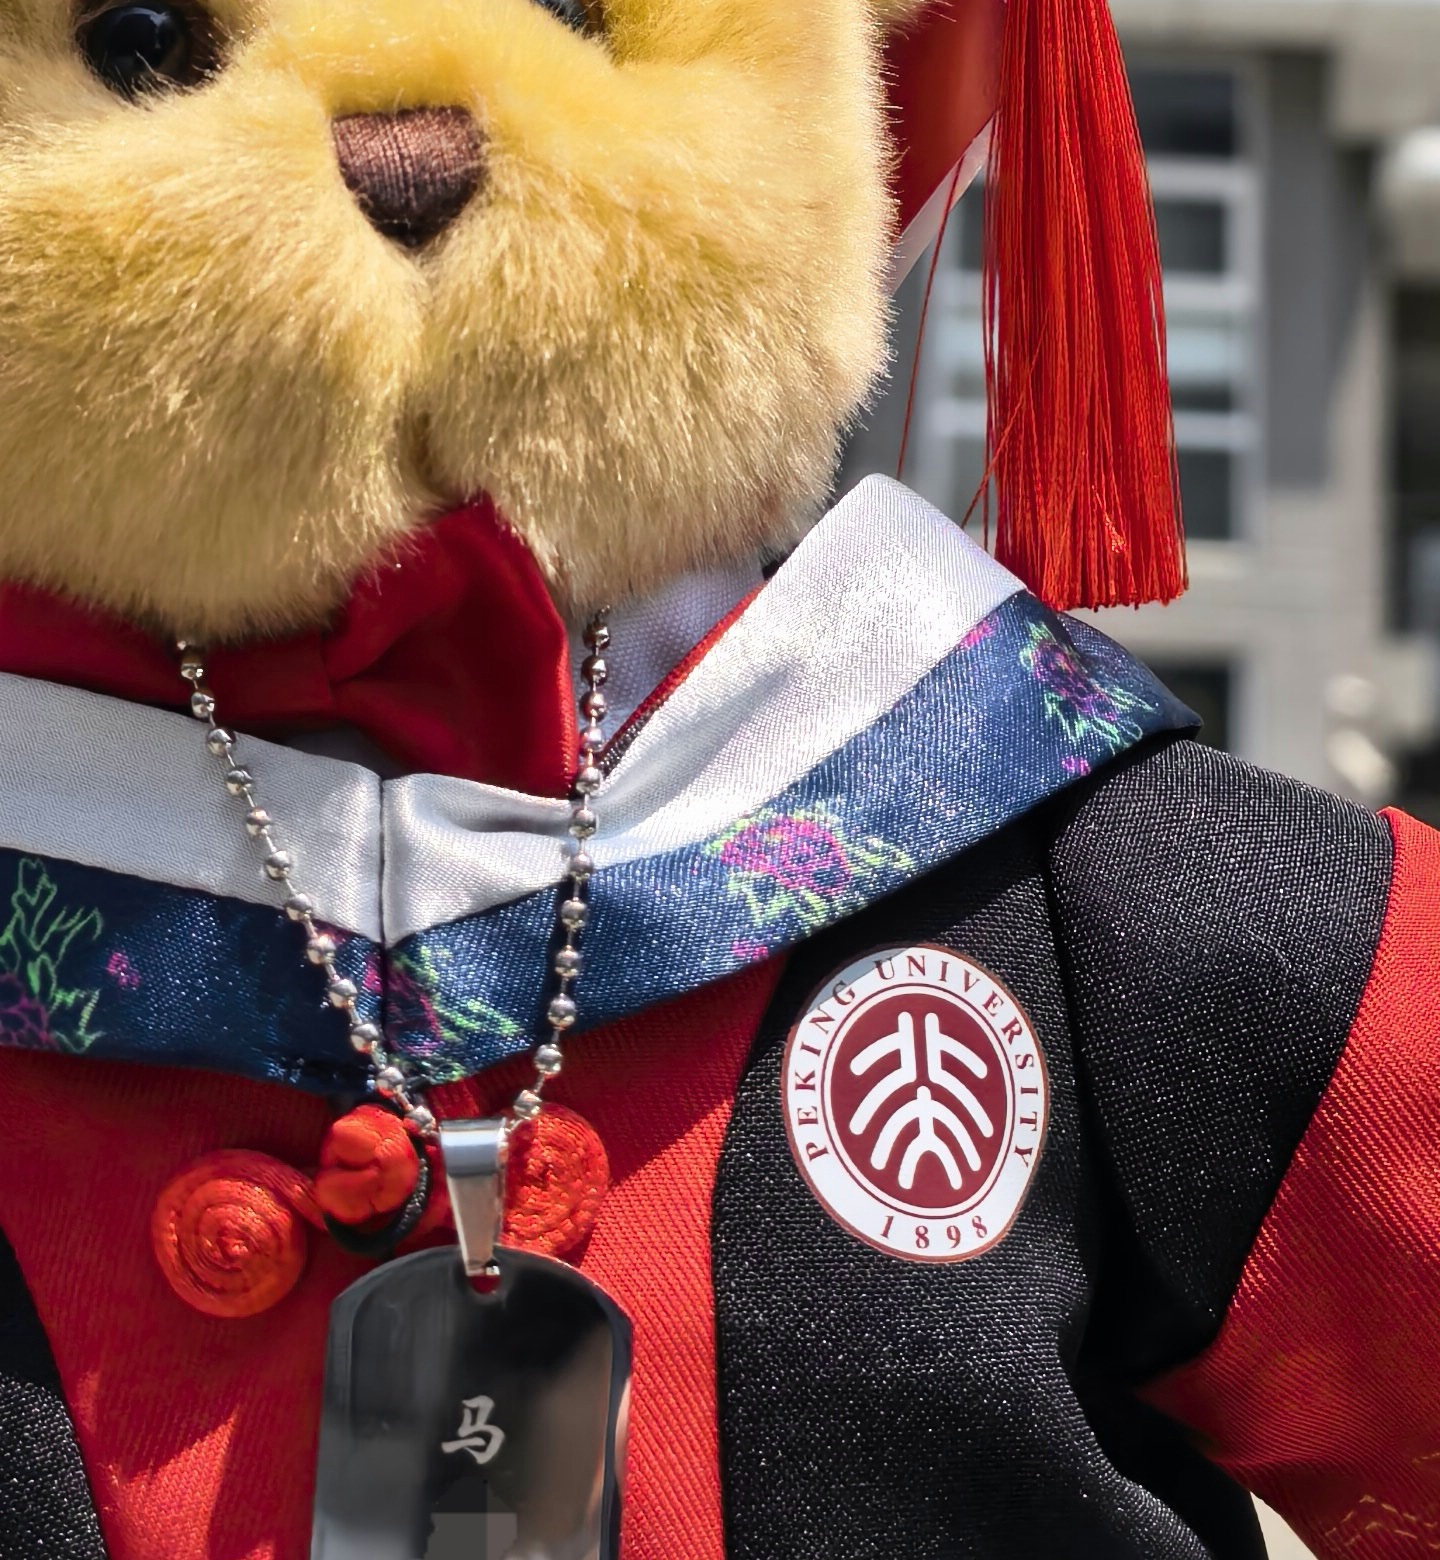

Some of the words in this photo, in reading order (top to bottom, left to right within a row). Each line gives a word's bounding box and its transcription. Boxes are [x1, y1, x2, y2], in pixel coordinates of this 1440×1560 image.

[794, 980, 857, 1163] PEKING
[871, 954, 1040, 1168] UNIVERSITY
[879, 1214, 989, 1250] 1898
[441, 1393, 505, 1465] 马
